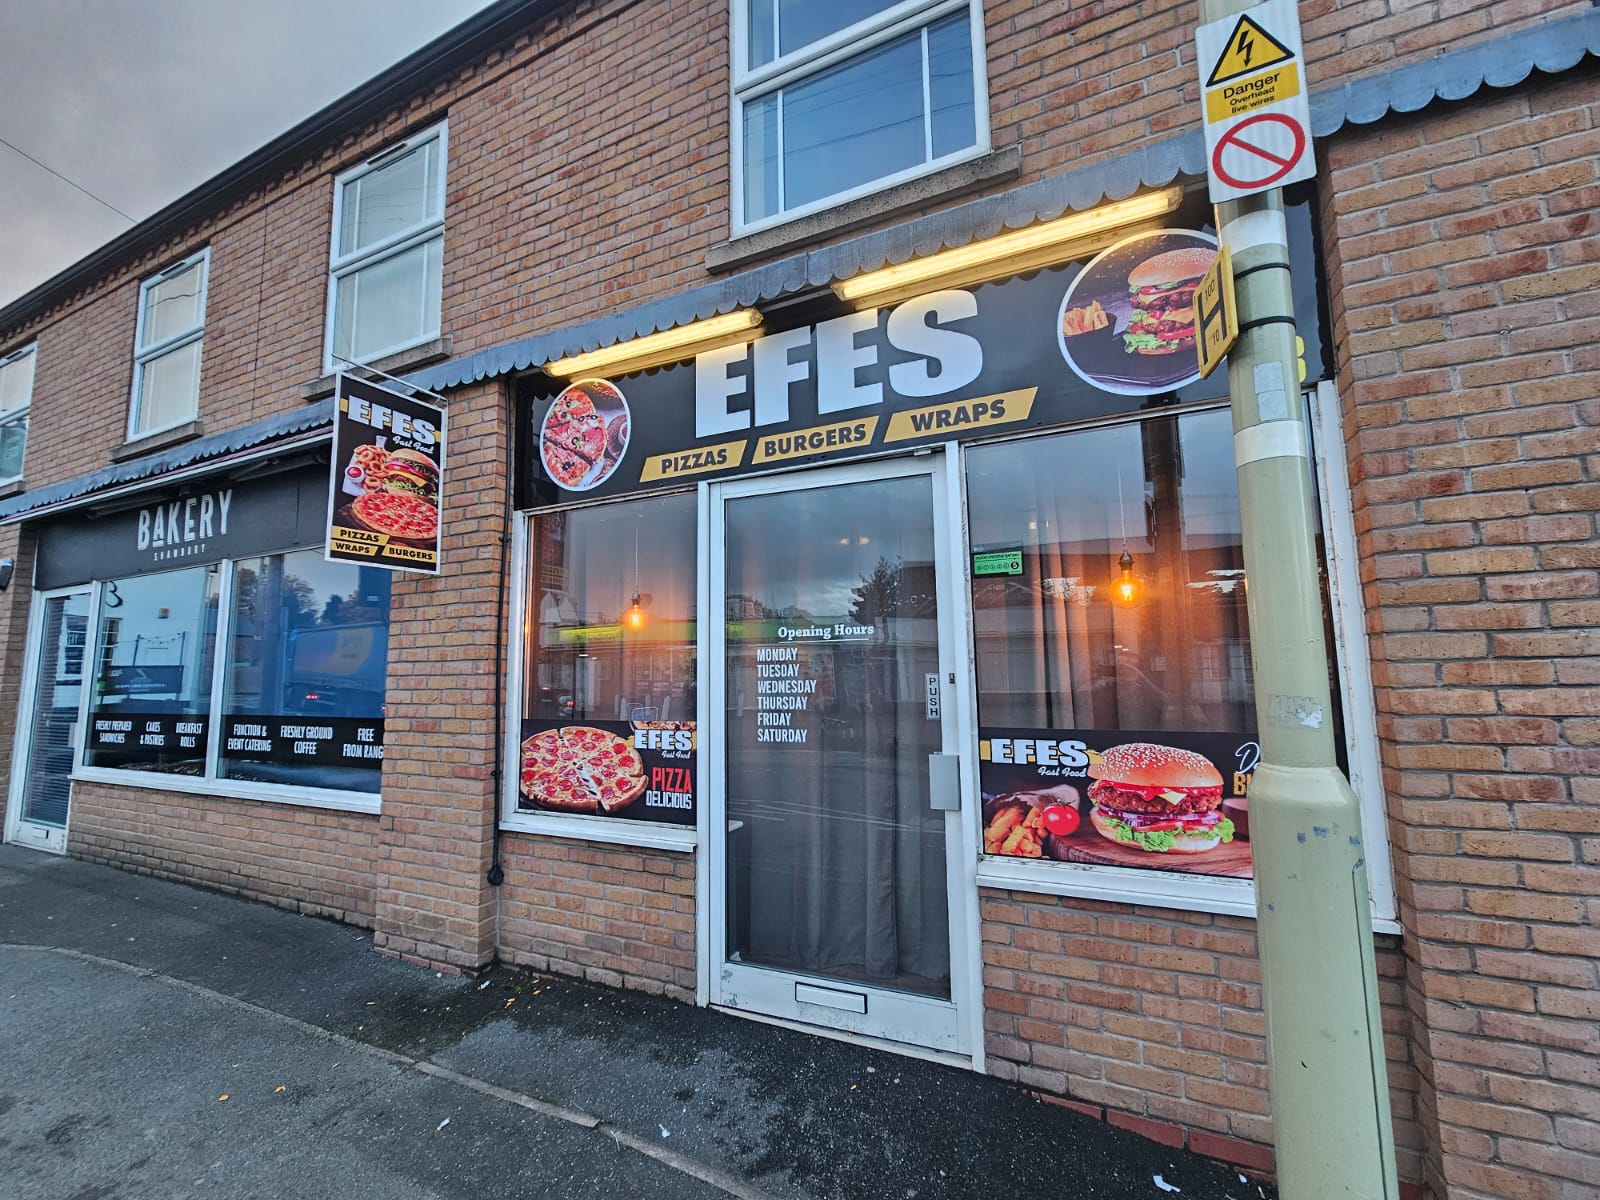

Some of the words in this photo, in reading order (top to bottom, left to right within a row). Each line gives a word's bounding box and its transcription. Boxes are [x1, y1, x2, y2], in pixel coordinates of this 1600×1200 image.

[1223, 72, 1280, 99] Danger
[1230, 86, 1275, 106] Overhead
[1231, 105, 1247, 114] live
[1249, 95, 1275, 107] wires
[1204, 279, 1215, 301] 100
[1197, 261, 1227, 366] H
[1212, 328, 1220, 346] 10
[695, 289, 983, 438] EFES
[348, 395, 435, 445] EFES
[910, 398, 1006, 432] WRAPS
[392, 435, 412, 448] Fast
[413, 441, 434, 454] Food
[763, 423, 866, 458] BURGERS
[661, 447, 728, 475] PIZZAS
[137, 488, 233, 551] BAKERY
[340, 528, 380, 543] PIZZAS
[335, 541, 370, 554] WRAPS
[389, 547, 433, 560] BURGERS
[777, 625, 832, 640] Opening
[833, 624, 875, 635] Hours
[756, 648, 798, 661] MONDAY
[757, 664, 799, 678] TUESDAY
[757, 680, 817, 693] WEDNESDAY
[757, 696, 808, 710] THURSDAY
[928, 677, 939, 717] PUSH
[757, 712, 791, 726] FRIDAY
[233, 724, 261, 737] FUNCTION
[280, 725, 305, 739] FRESHLY
[305, 726, 333, 740] GROUND
[357, 728, 375, 742] FREE
[757, 729, 808, 743] SATURDAY
[227, 738, 244, 750] EVENT
[244, 738, 272, 752] CATERING
[293, 741, 317, 755] COFFEE
[634, 729, 693, 751] EFES
[342, 744, 363, 758] FROM
[363, 745, 384, 759] RANG
[990, 738, 1089, 767] EFES
[652, 767, 692, 792] PIZZA
[1037, 766, 1060, 776] Fast
[1061, 767, 1087, 778] Food
[645, 790, 692, 810] DELICIOUS
